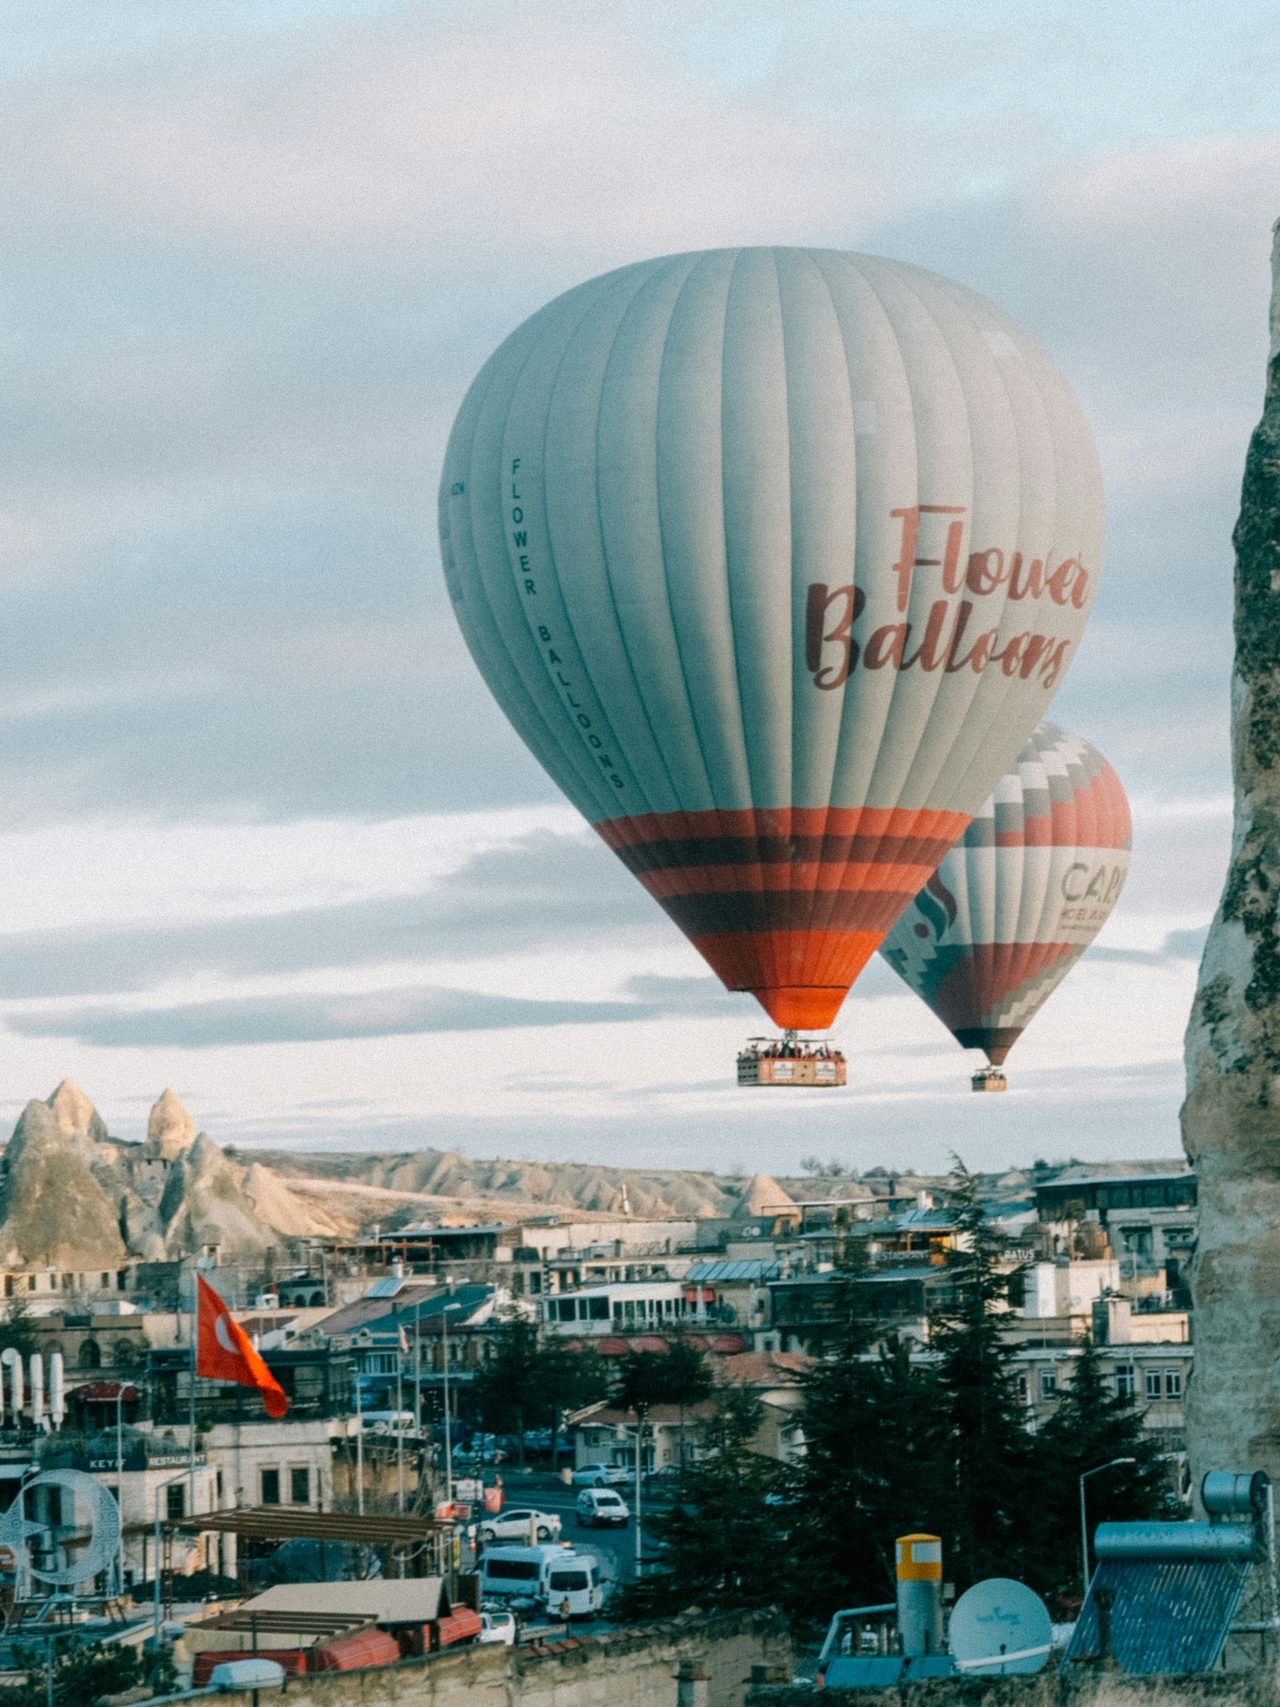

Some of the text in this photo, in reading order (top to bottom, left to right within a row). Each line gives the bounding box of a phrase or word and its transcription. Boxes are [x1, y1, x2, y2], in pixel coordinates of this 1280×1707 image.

[889, 504, 1089, 613] Flower
[511, 457, 625, 789] FLOWER BALLOONS
[805, 582, 1071, 691] Balloons
